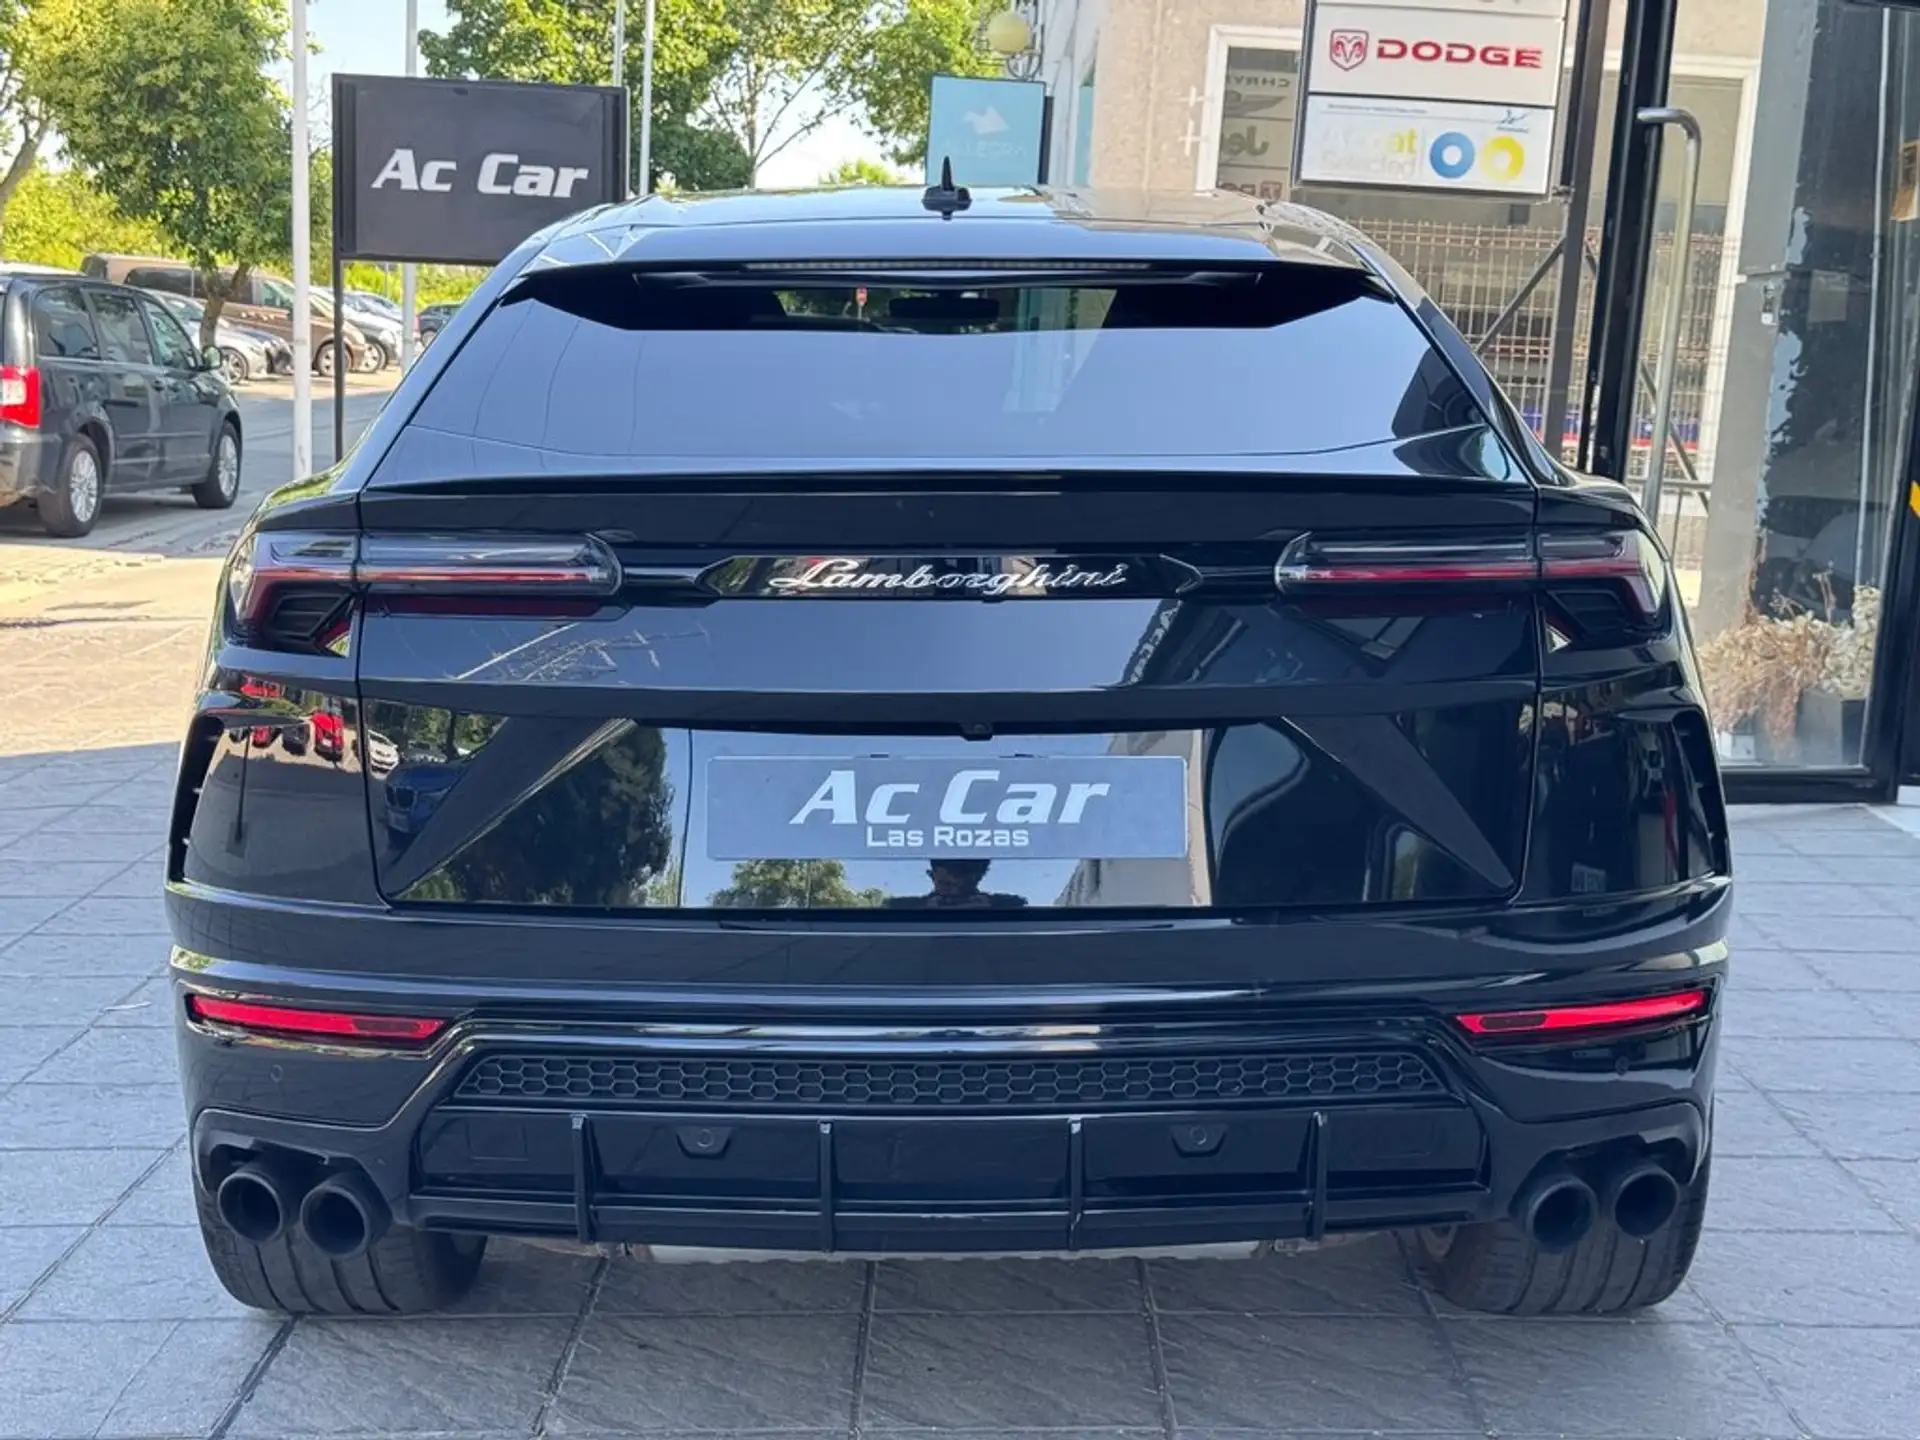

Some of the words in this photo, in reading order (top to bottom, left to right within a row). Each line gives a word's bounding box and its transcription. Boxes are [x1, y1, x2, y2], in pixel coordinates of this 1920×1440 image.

[1376, 39, 1543, 68] DODGE
[371, 148, 457, 192] Ac
[477, 153, 589, 198] Car
[768, 558, 1130, 596] Lamborghini
[789, 770, 920, 825] Ac
[938, 770, 1110, 825] Car
[866, 826, 923, 847] Las
[933, 826, 1030, 847] Rozas
